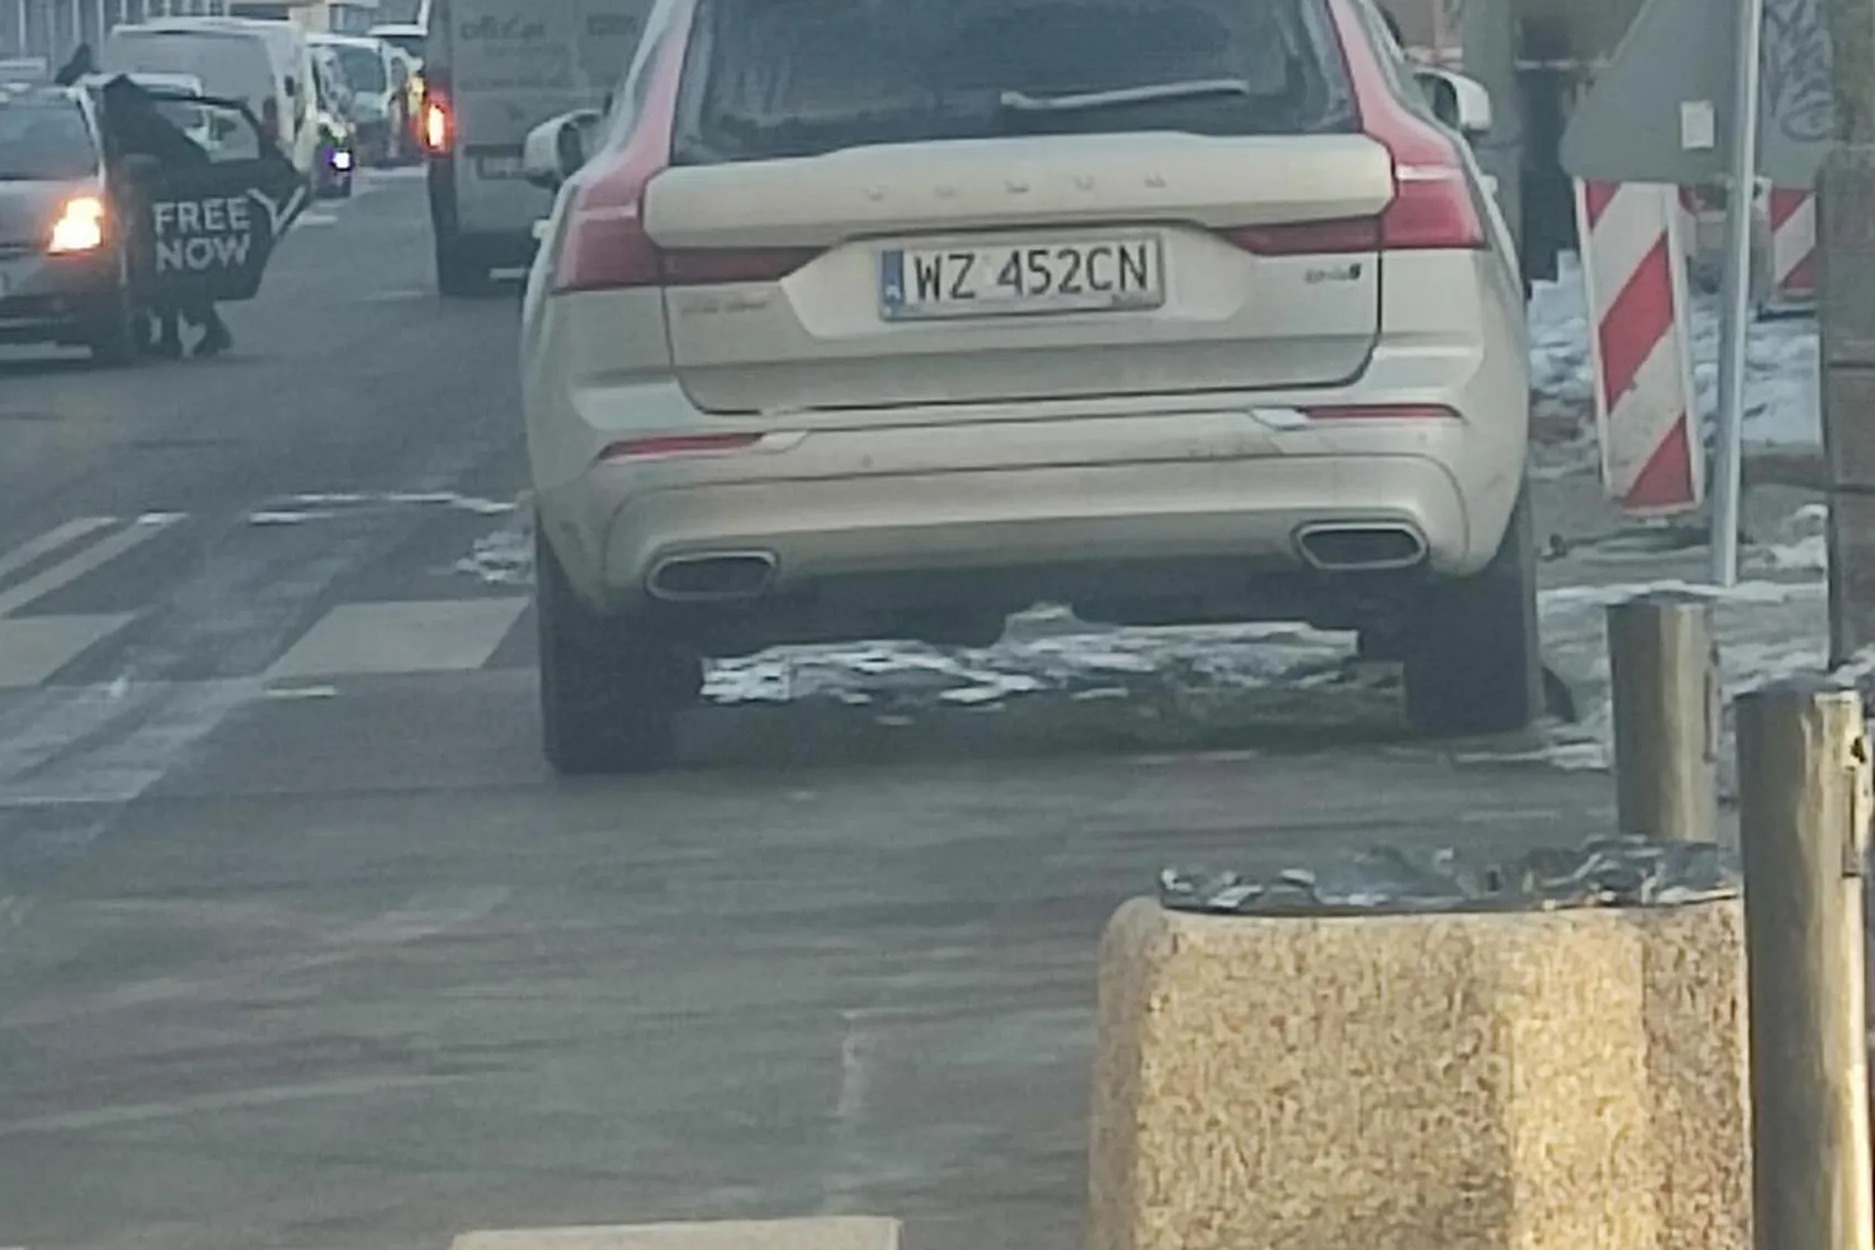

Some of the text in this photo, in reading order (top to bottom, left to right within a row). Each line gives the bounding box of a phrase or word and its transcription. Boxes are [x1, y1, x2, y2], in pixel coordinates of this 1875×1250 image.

[153, 197, 250, 236] FREE
[155, 233, 250, 271] NOW
[914, 244, 1148, 302] WZ 452CN
